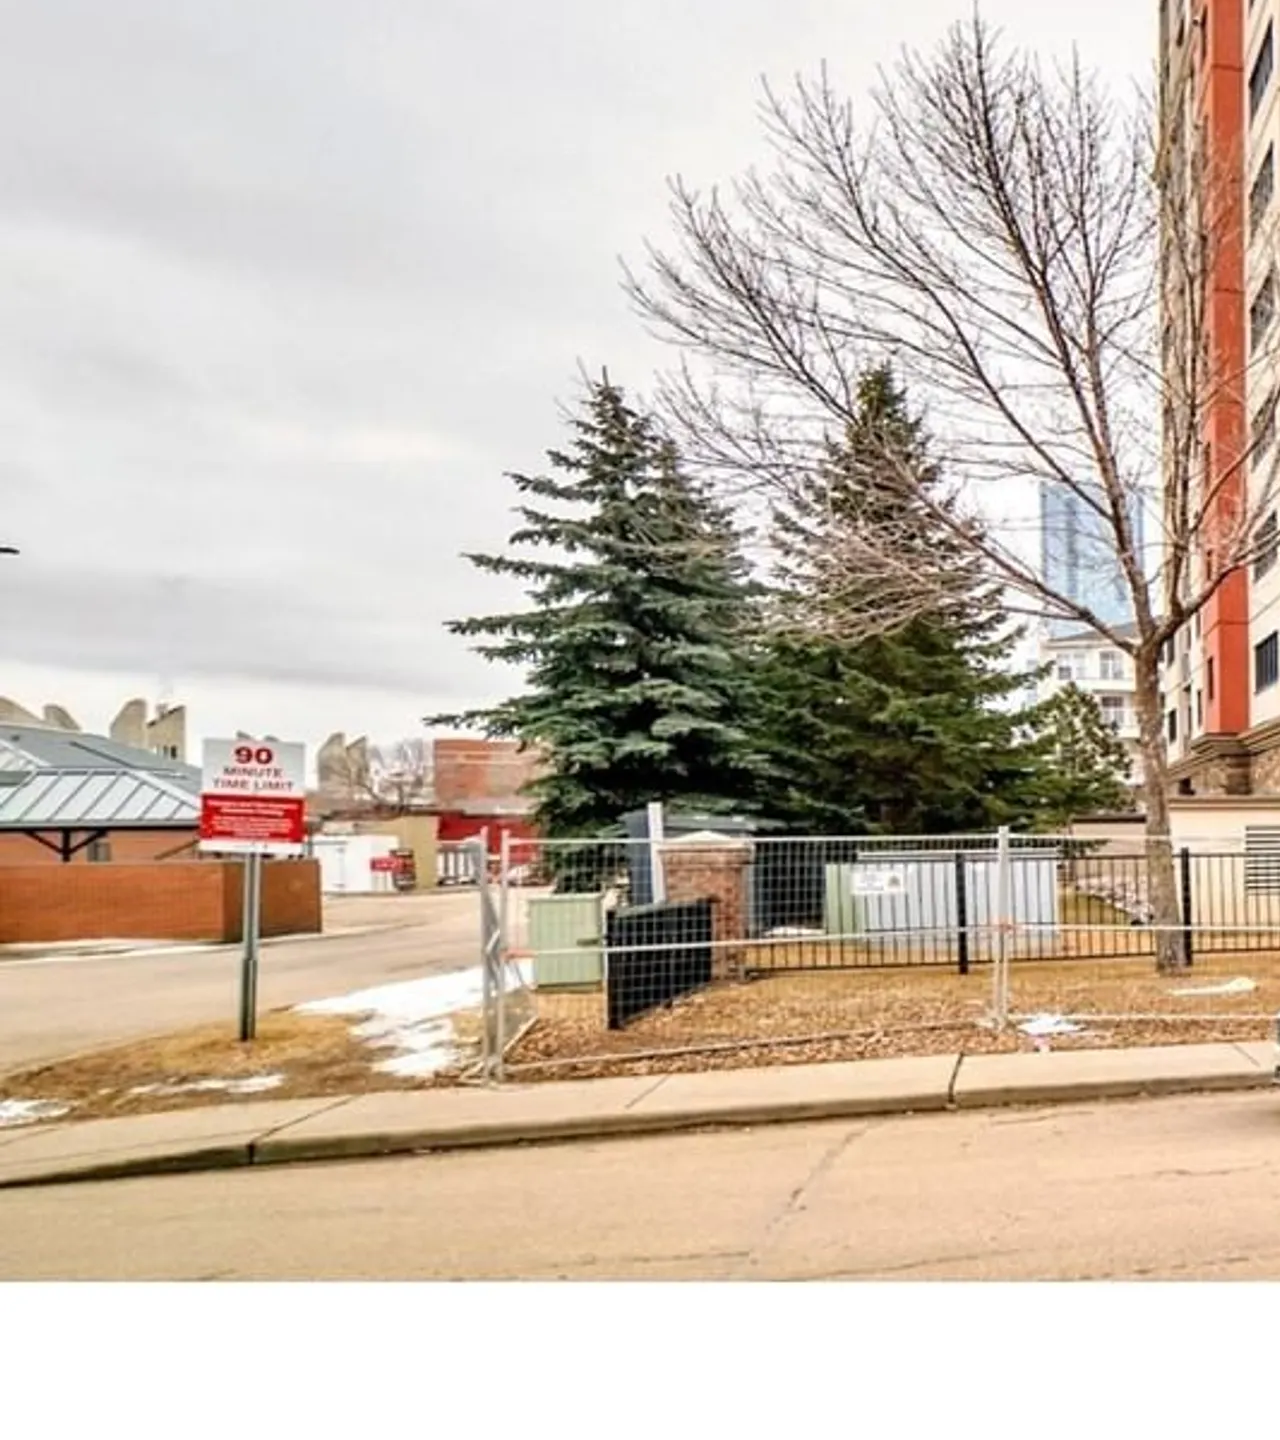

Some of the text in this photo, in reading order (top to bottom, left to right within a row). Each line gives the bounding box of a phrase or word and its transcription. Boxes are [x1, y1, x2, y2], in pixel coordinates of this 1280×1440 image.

[234, 746, 273, 765] 90
[223, 767, 284, 777] MINUTE
[213, 779, 293, 791] TIME LIMIT
